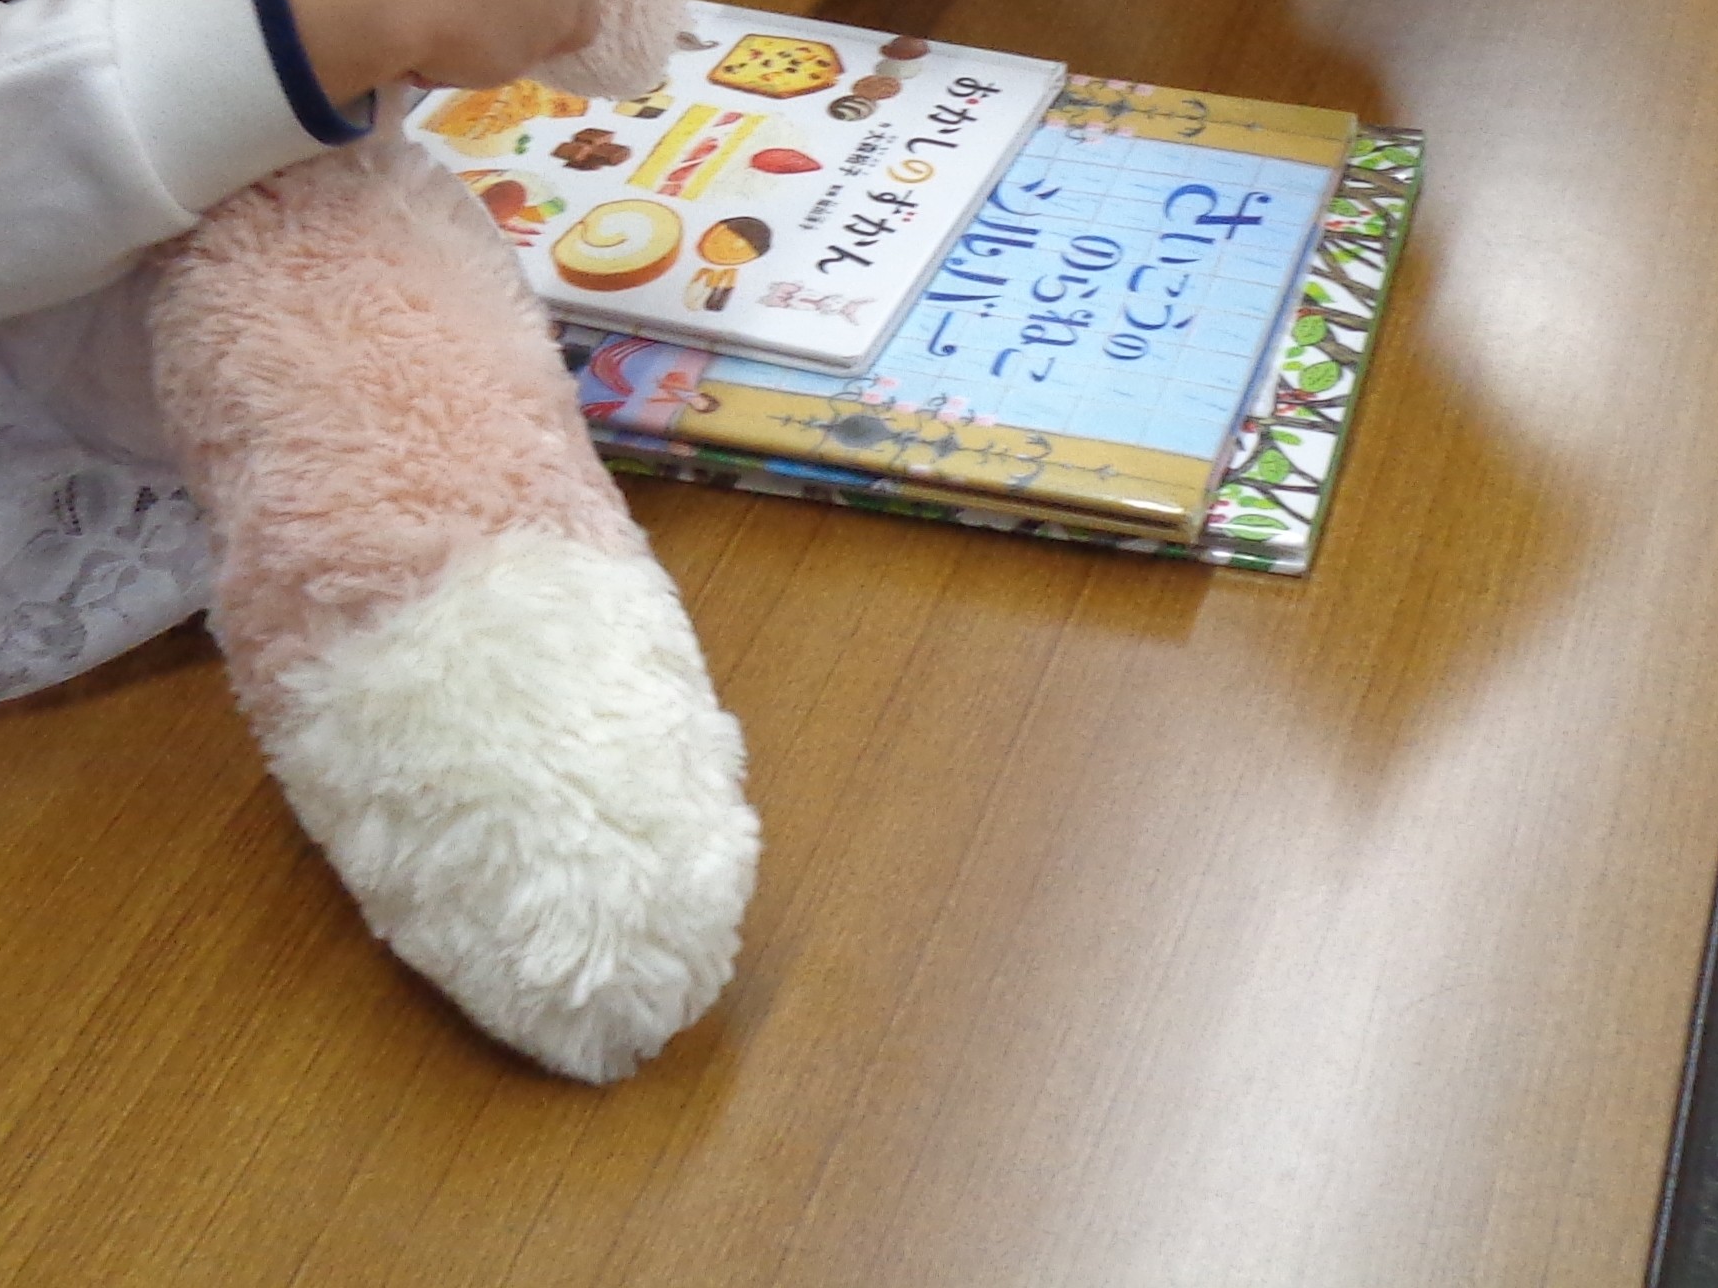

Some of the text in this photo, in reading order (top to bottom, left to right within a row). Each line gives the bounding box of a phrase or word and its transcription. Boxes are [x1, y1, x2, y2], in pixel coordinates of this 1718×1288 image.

[815, 77, 1002, 274] おかしのずかん
[926, 178, 1062, 357] シルバー
[990, 235, 1122, 383] のらねこ
[1103, 184, 1272, 361] さいこうの
